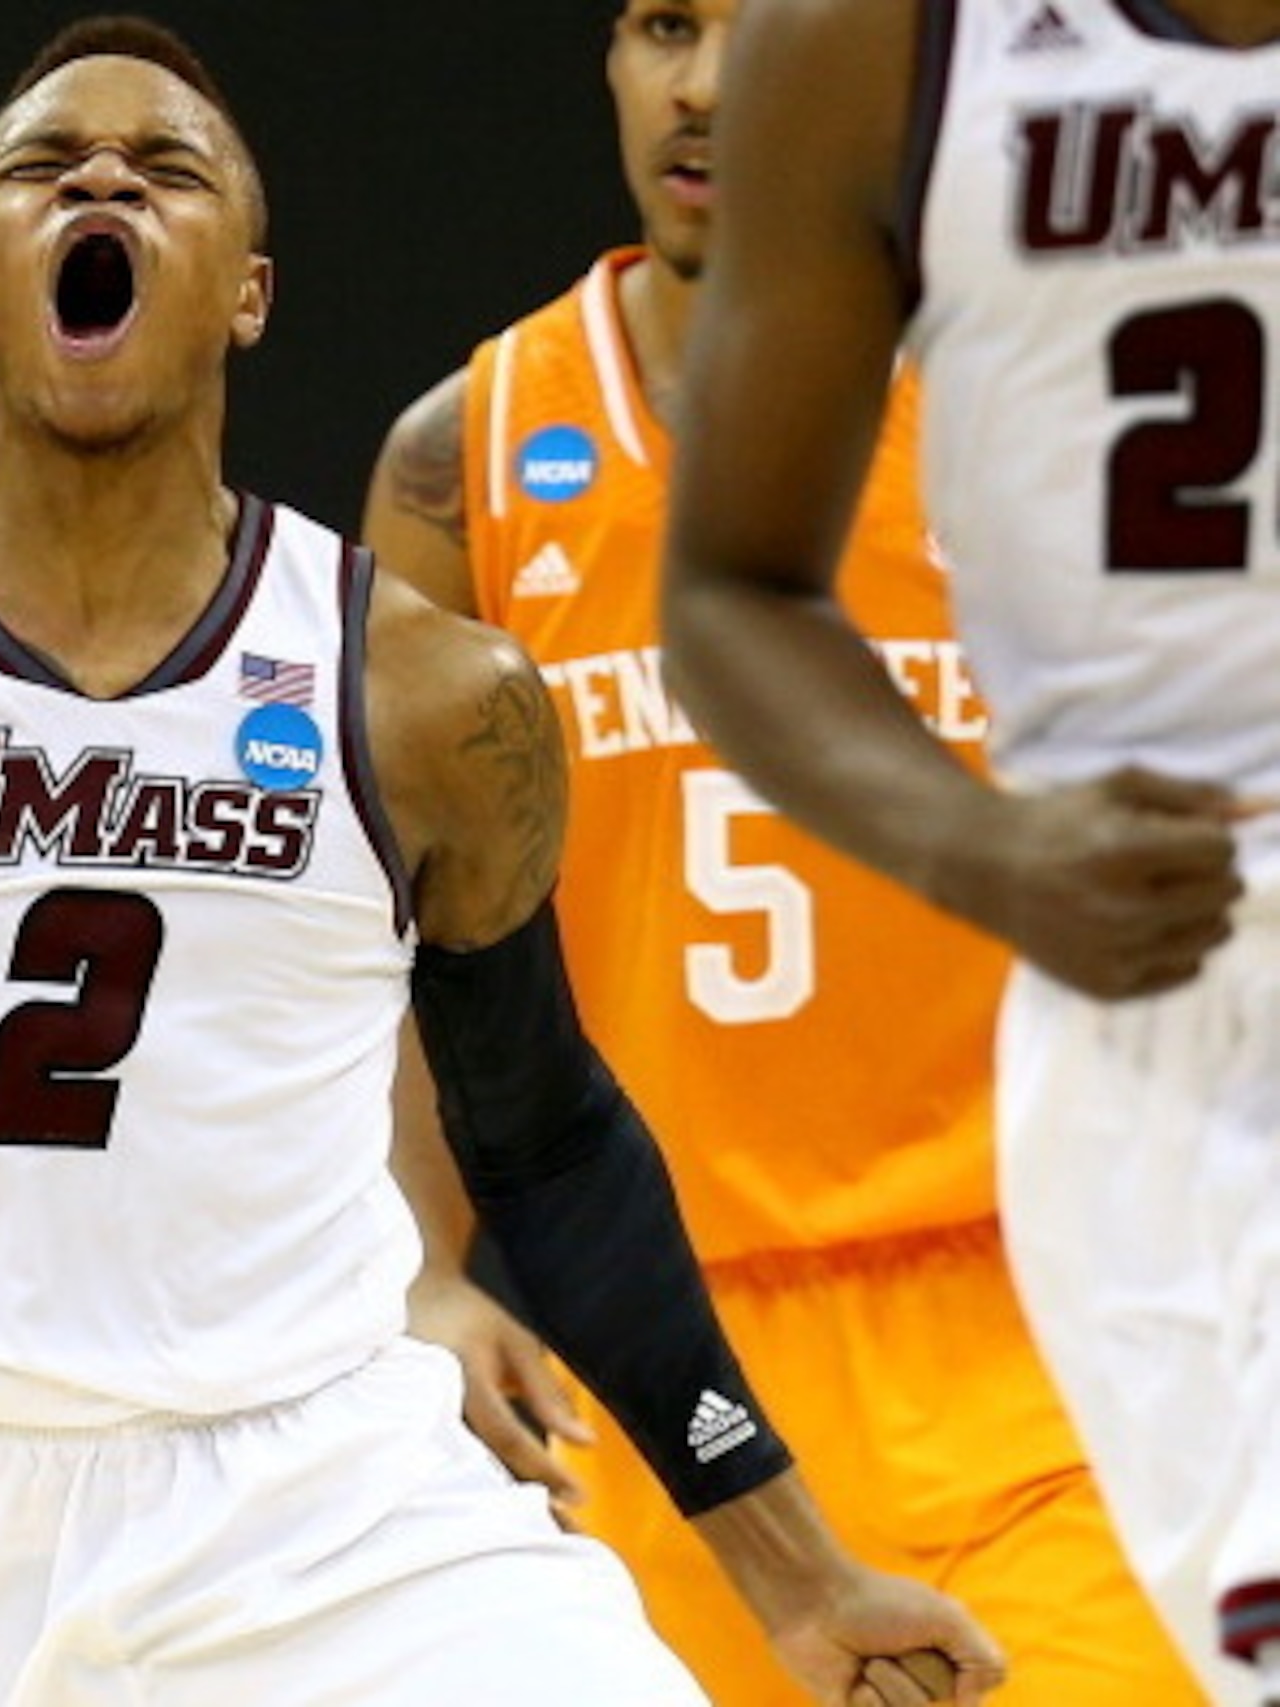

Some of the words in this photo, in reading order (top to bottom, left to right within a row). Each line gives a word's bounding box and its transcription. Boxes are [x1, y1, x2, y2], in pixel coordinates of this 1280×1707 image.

[1005, 95, 1280, 258] UM
[244, 739, 317, 774] NCAA
[680, 769, 815, 1024] 5
